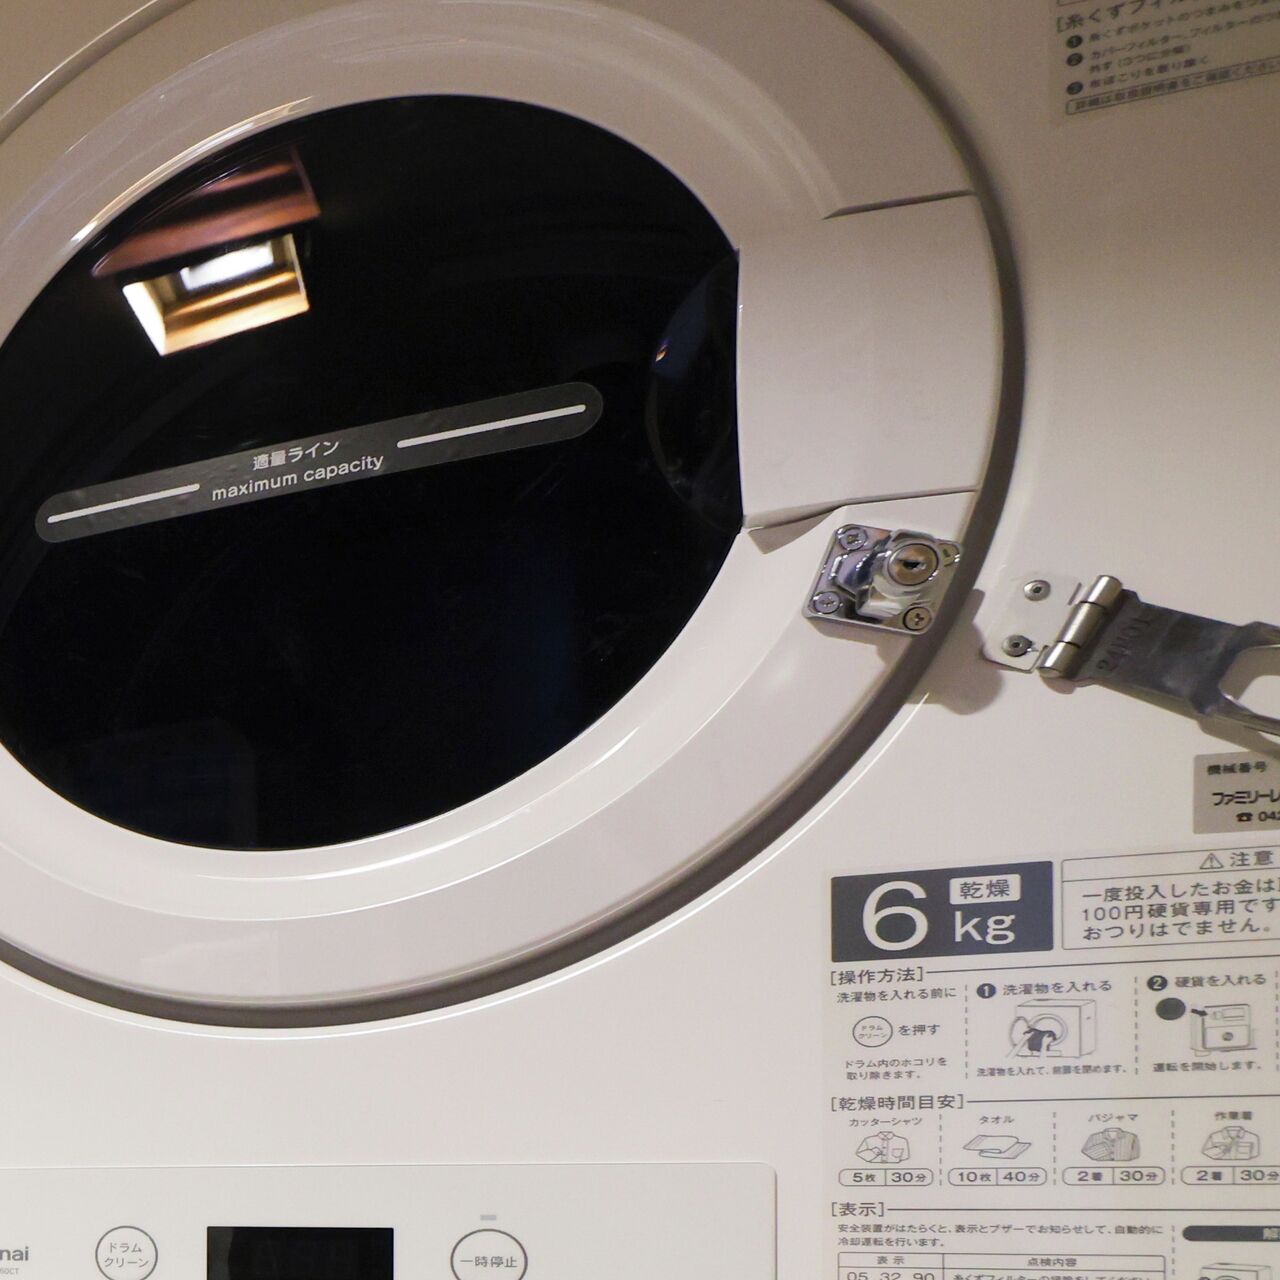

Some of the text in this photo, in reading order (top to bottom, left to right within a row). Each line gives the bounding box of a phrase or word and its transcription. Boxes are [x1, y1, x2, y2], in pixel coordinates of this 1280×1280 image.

[252, 440, 340, 472] 適量ライン
[212, 454, 385, 502] maximum capacity
[1230, 850, 1274, 868] 注意
[959, 880, 1011, 900] 乾燥
[1082, 877, 1280, 902] 一度投入したお金は
[862, 880, 929, 952] 6
[954, 911, 1016, 946] kg
[1083, 917, 1271, 940] おつりはでません。
[1002, 980, 1112, 996] 洗濯物を入れる
[1175, 974, 1267, 988] 硬貨を入れる
[898, 1024, 940, 1036] を押す
[849, 1117, 923, 1127] カッターシャツ
[979, 1115, 1015, 1125] タオル
[891, 1172, 927, 1183] 30分
[958, 1171, 992, 1182] 10枚
[1003, 1171, 1040, 1182] 40分
[1120, 1170, 1158, 1182] 30分
[107, 1241, 142, 1254] ドラム
[104, 1256, 149, 1269] クリーン
[460, 1254, 518, 1269] 一時停止
